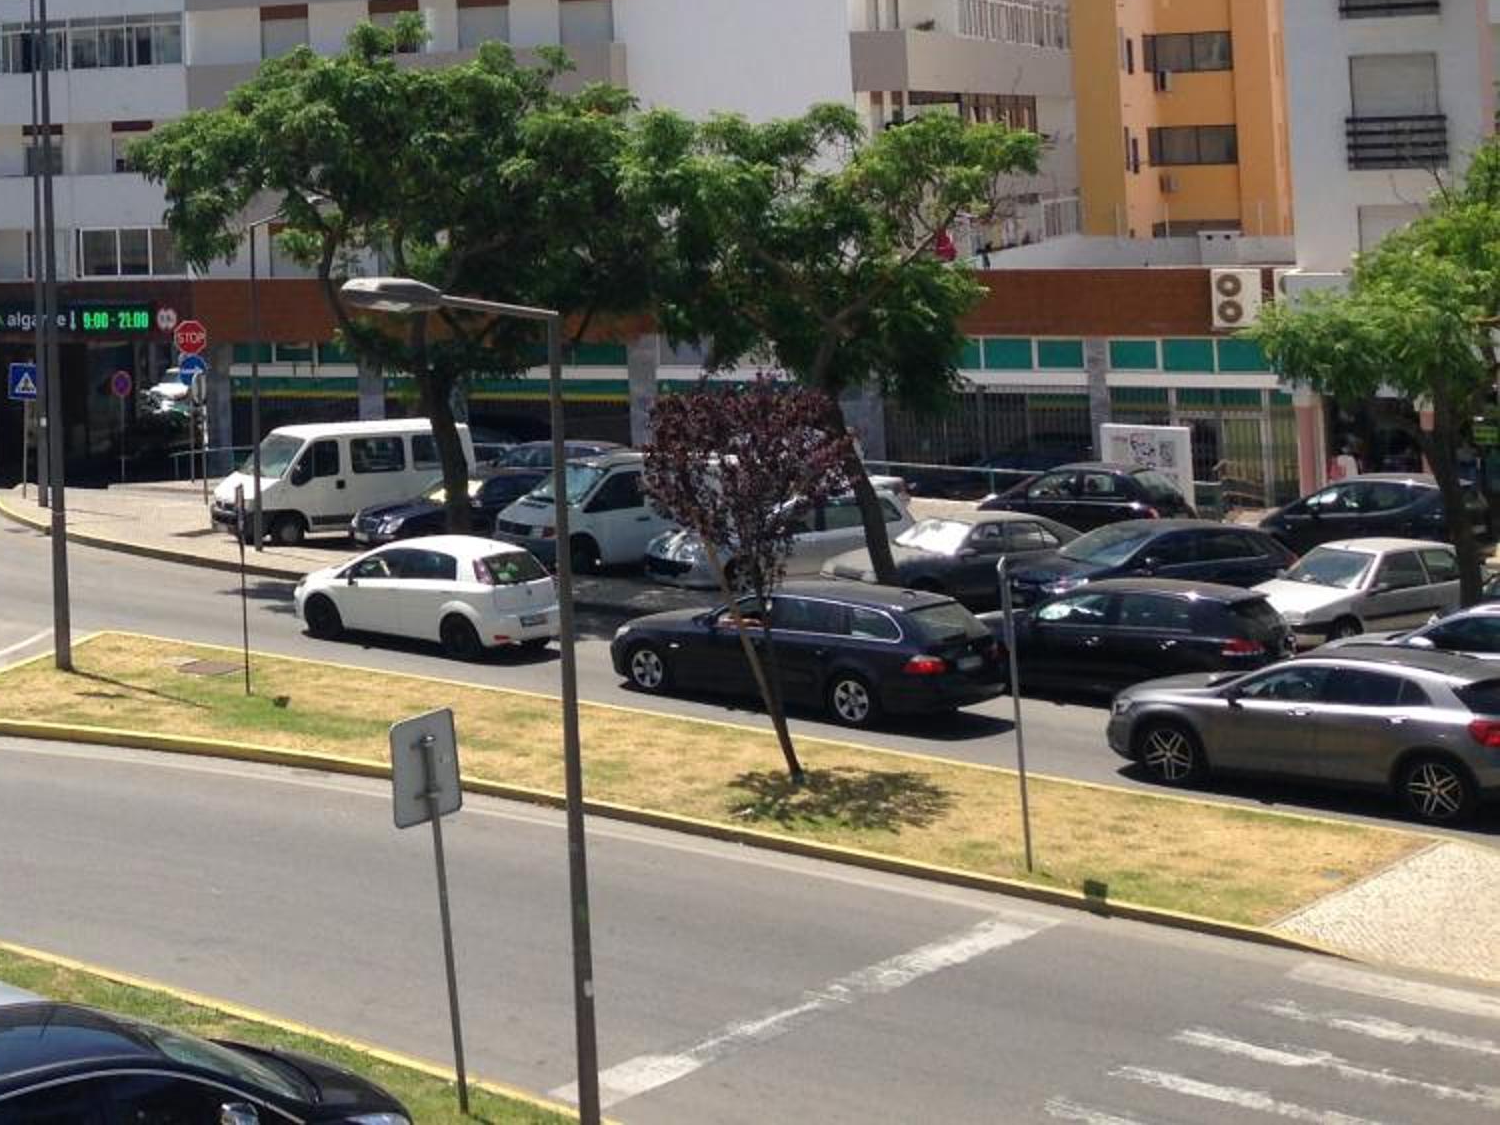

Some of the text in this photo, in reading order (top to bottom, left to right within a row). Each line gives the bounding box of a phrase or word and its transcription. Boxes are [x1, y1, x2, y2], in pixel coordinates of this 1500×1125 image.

[7, 311, 67, 330] algare
[83, 311, 109, 330] 9:00
[118, 311, 149, 330] 21:00
[177, 332, 206, 344] STOP
